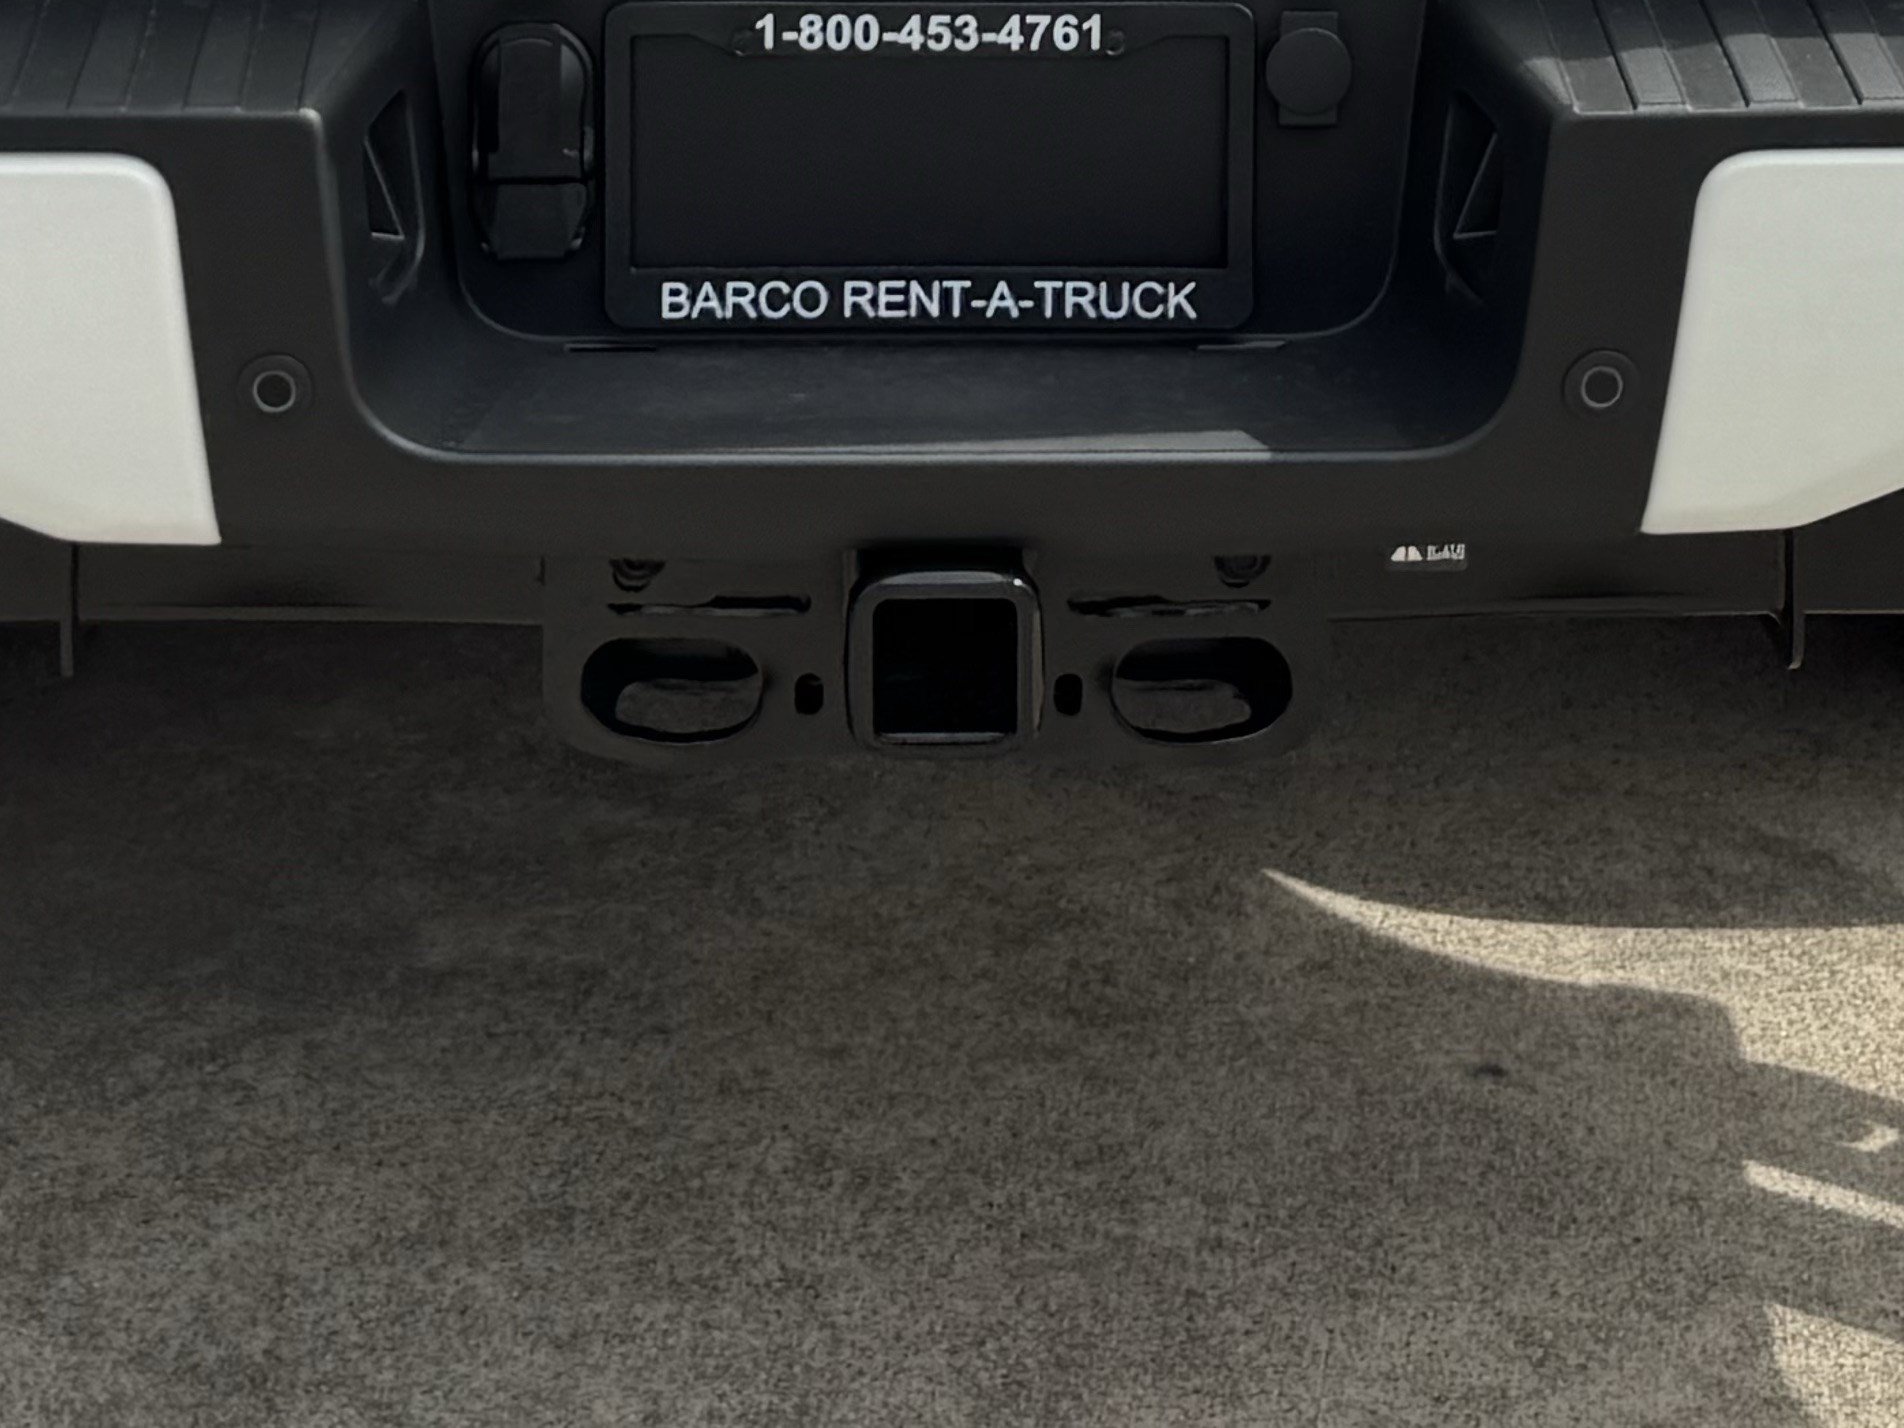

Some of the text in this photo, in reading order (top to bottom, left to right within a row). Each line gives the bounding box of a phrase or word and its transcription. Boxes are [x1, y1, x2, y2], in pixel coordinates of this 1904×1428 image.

[753, 13, 1102, 52] 1-800-453-4761
[660, 279, 1198, 321] BARCO RENT-A-TRUCK
